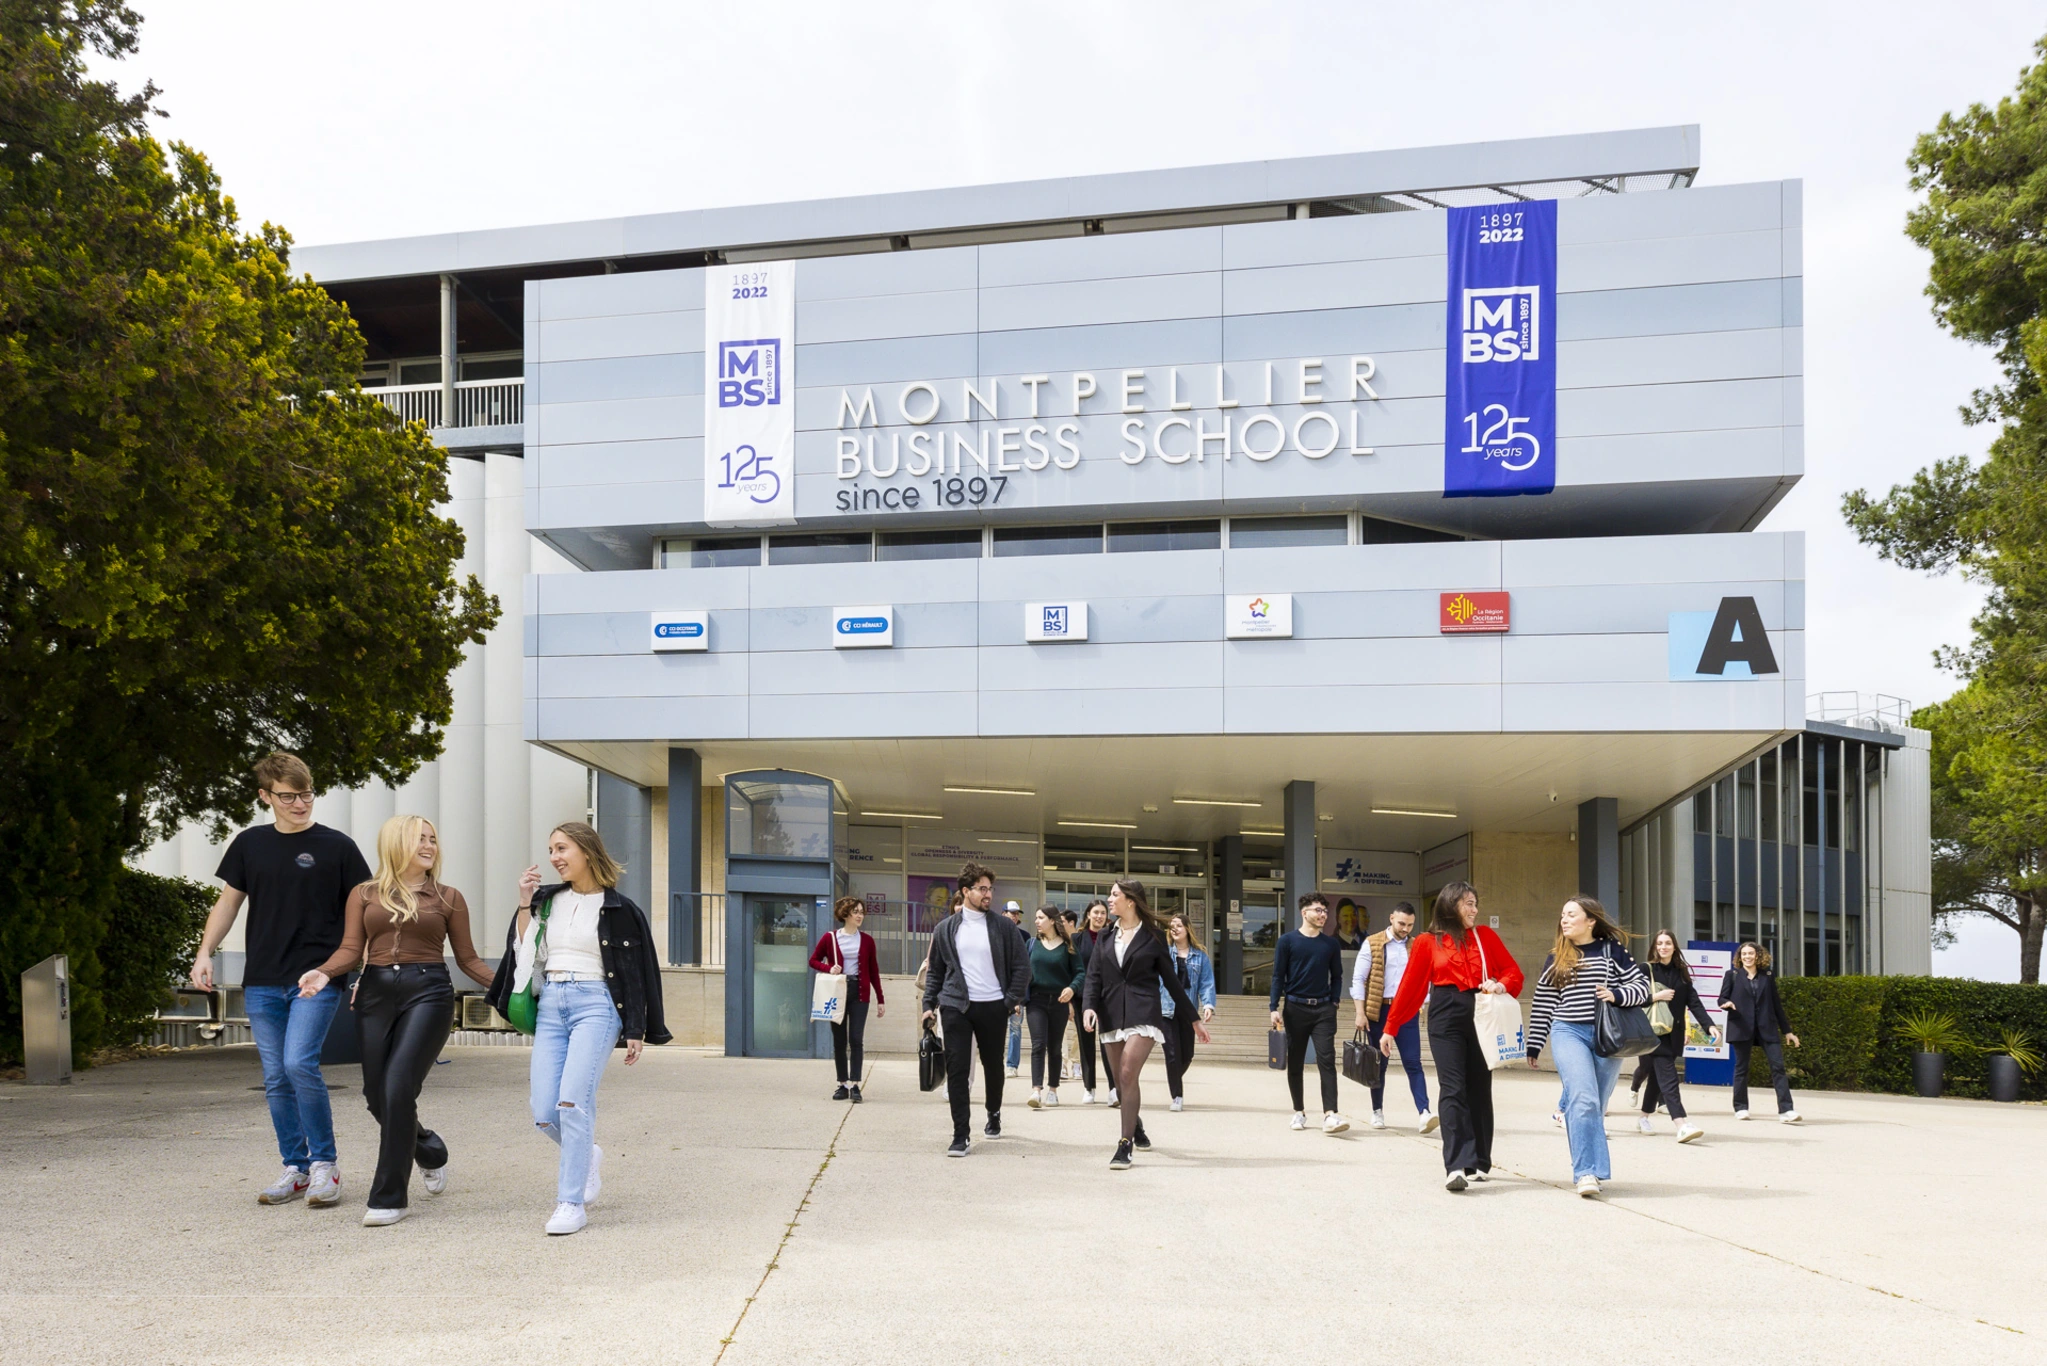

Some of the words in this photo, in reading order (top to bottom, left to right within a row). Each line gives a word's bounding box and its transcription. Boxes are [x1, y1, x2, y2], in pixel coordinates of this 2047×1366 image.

[1480, 212, 1524, 228] 1897
[1479, 228, 1524, 244] 2022
[732, 272, 768, 286] 1897
[732, 286, 768, 299] 2022
[1520, 298, 1529, 320] 1897
[1520, 322, 1529, 349] since
[765, 349, 773, 369] 1897
[765, 371, 773, 395] since
[837, 356, 1379, 429] MONTPELLIER
[837, 423, 1081, 480] BUSINESS
[1119, 410, 1374, 465] SCHOOL
[1461, 403, 1540, 471] 125
[1484, 447, 1522, 461] years
[717, 444, 781, 504] 125
[736, 483, 767, 494] years
[836, 482, 920, 511] since
[932, 476, 1008, 506] 1897
[1695, 596, 1780, 675] A
